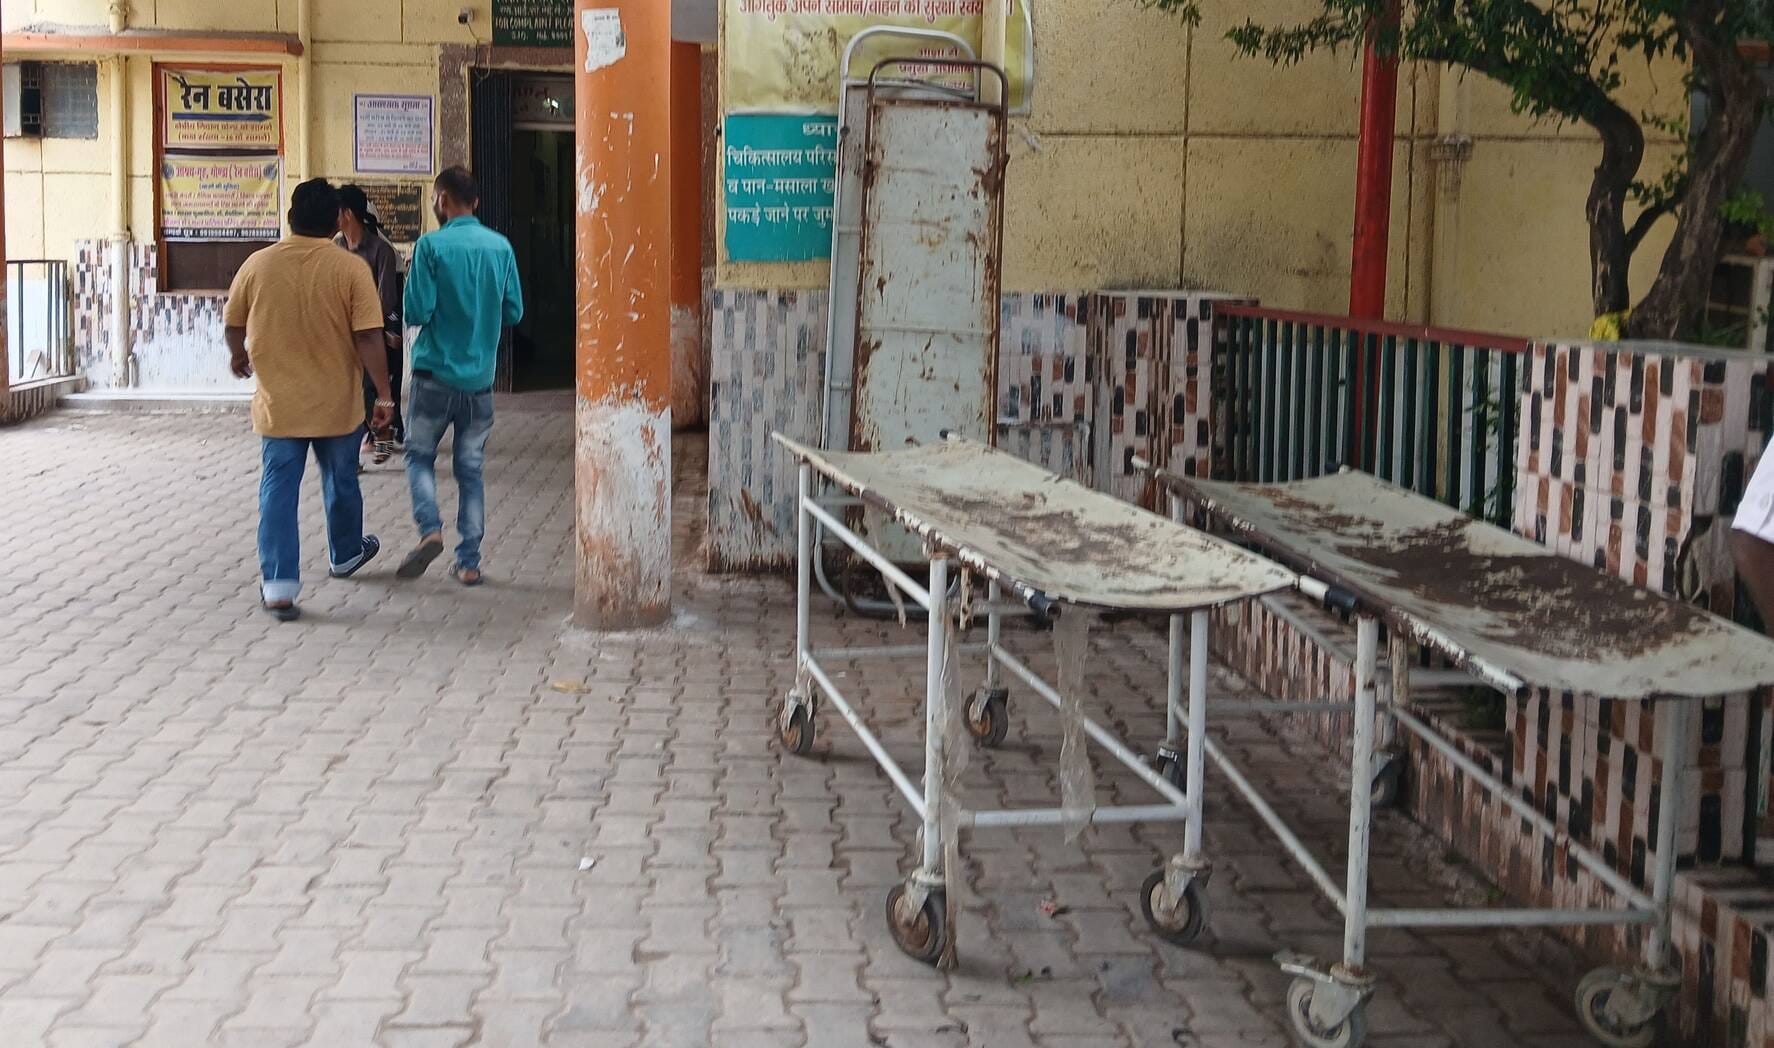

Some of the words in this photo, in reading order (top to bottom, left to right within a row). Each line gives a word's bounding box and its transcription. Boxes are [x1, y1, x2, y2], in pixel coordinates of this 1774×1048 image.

[740, 0, 787, 21] आगतुक
[171, 75, 212, 110] रैन
[217, 76, 273, 111] बसेरा
[803, 122, 838, 136] ध्या
[727, 144, 803, 167] चिकित्सालय
[727, 178, 739, 195] व
[741, 178, 818, 195] पान-मसाला
[764, 200, 790, 223] जाने
[792, 206, 810, 223] पर
